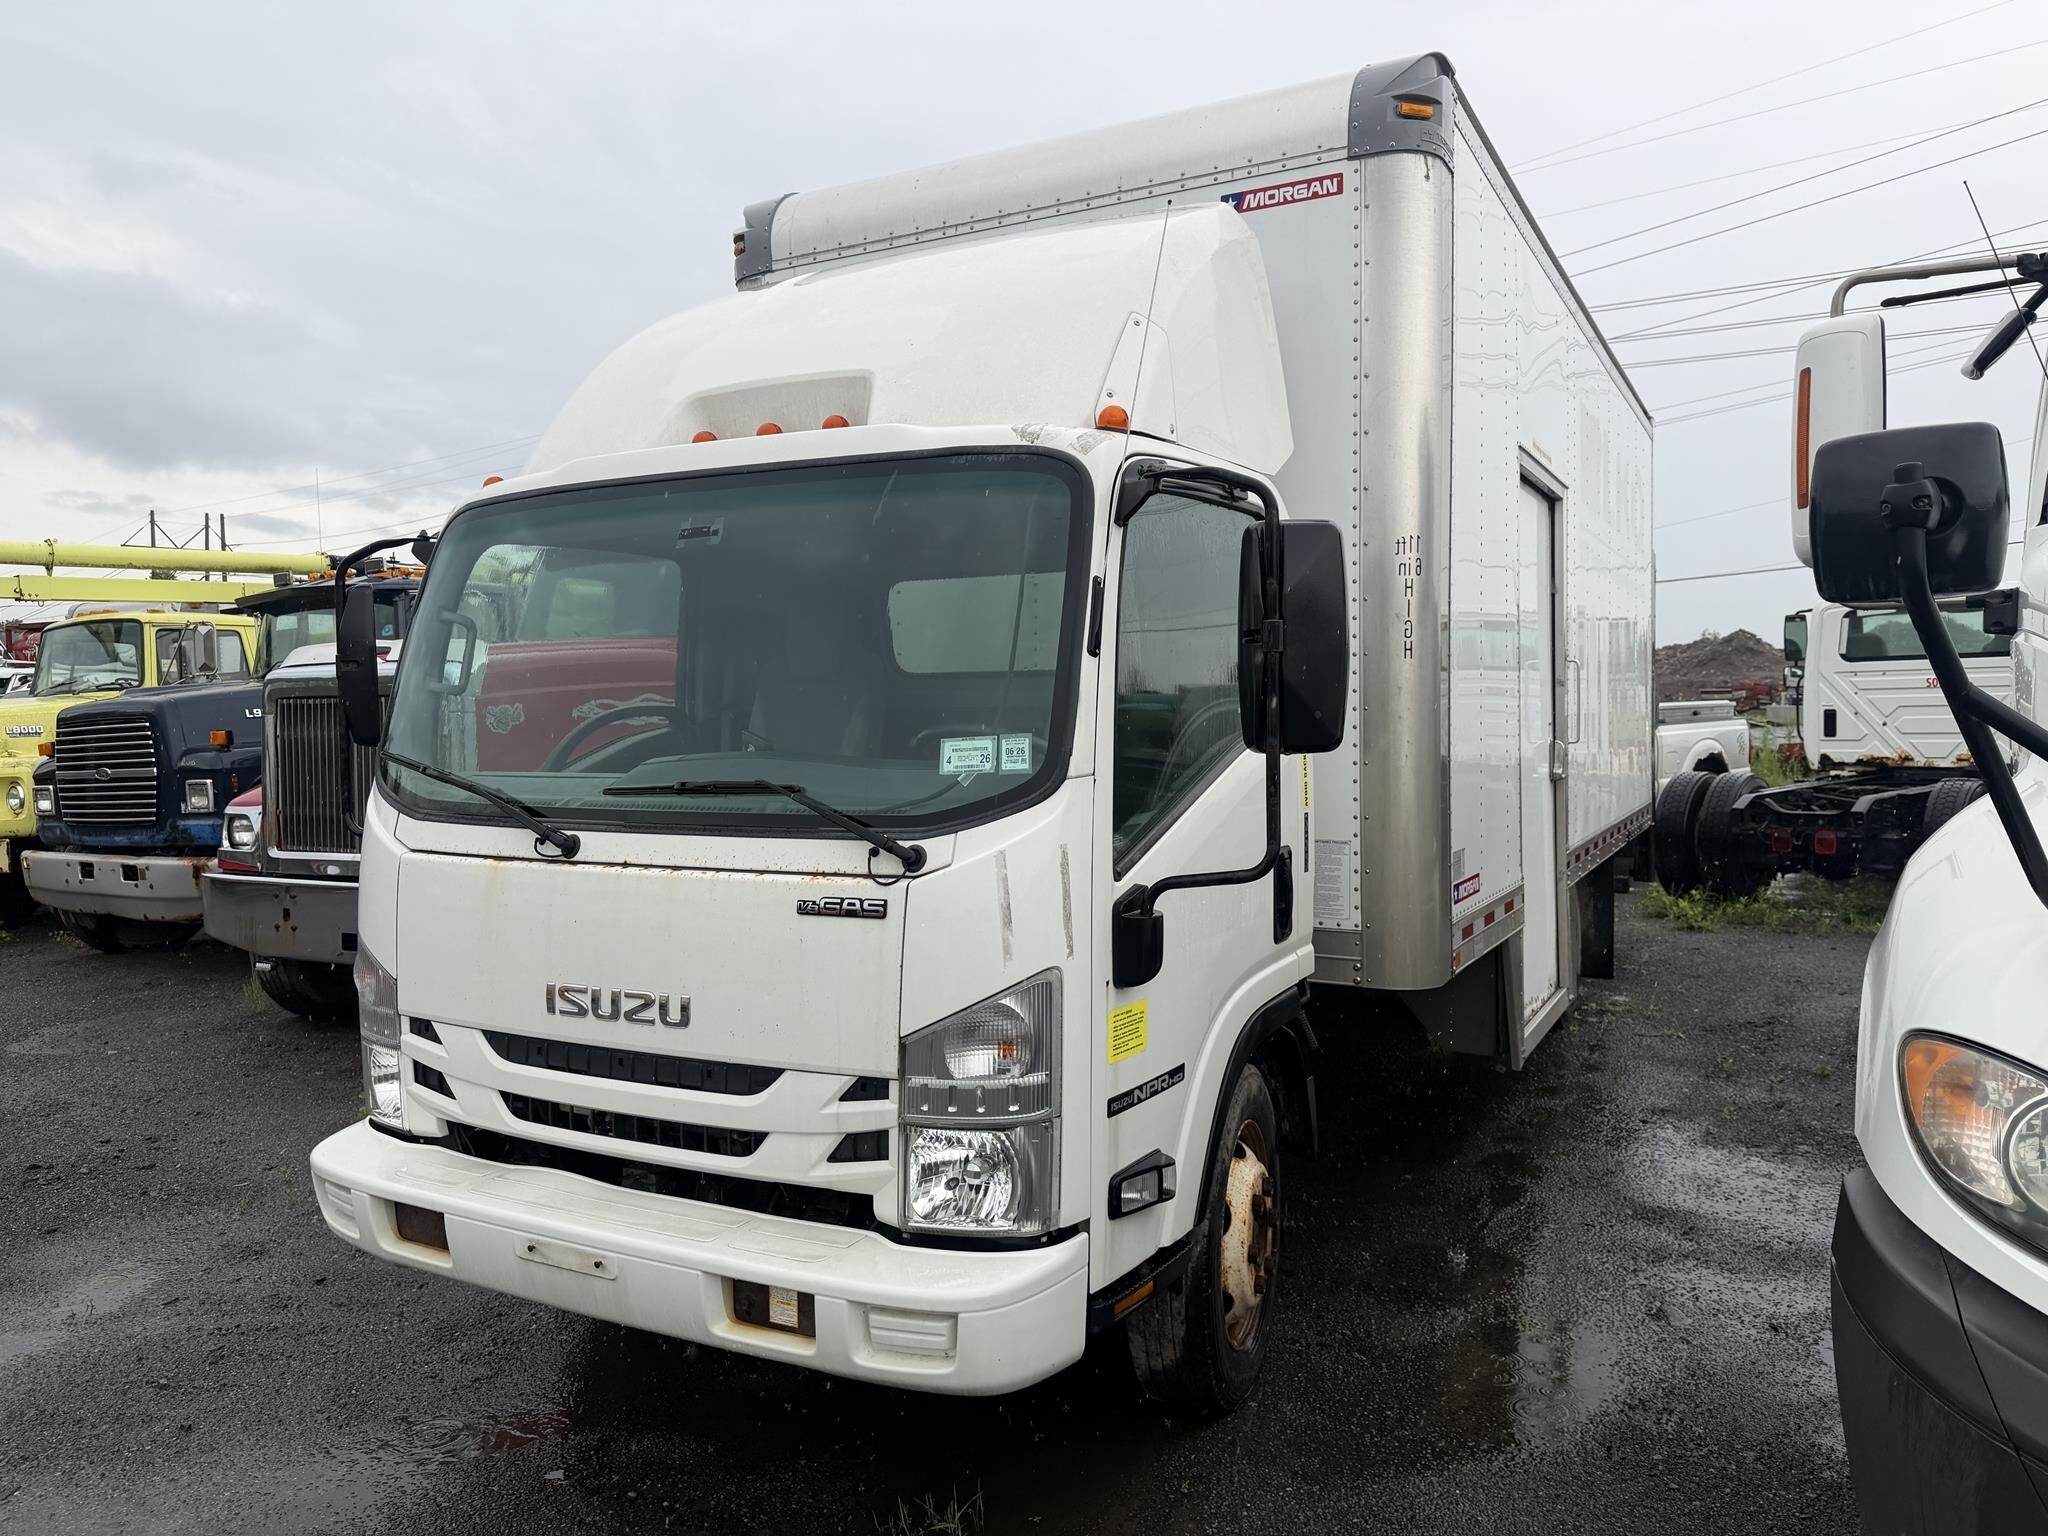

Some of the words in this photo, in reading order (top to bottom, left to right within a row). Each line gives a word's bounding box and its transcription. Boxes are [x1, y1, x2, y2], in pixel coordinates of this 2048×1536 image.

[1242, 177, 1339, 210] MORGAN
[245, 708, 264, 718] L9
[6, 725, 44, 734] L8000
[946, 755, 952, 765] 4
[980, 753, 991, 764] 26
[1005, 747, 1014, 756] 06
[1016, 746, 1026, 756] 26
[819, 897, 885, 917] GAS
[545, 981, 691, 1030] ISUZU
[1110, 1094, 1133, 1112] ISUZU
[1133, 1074, 1169, 1105] NPR
[1169, 1072, 1183, 1086] HD
